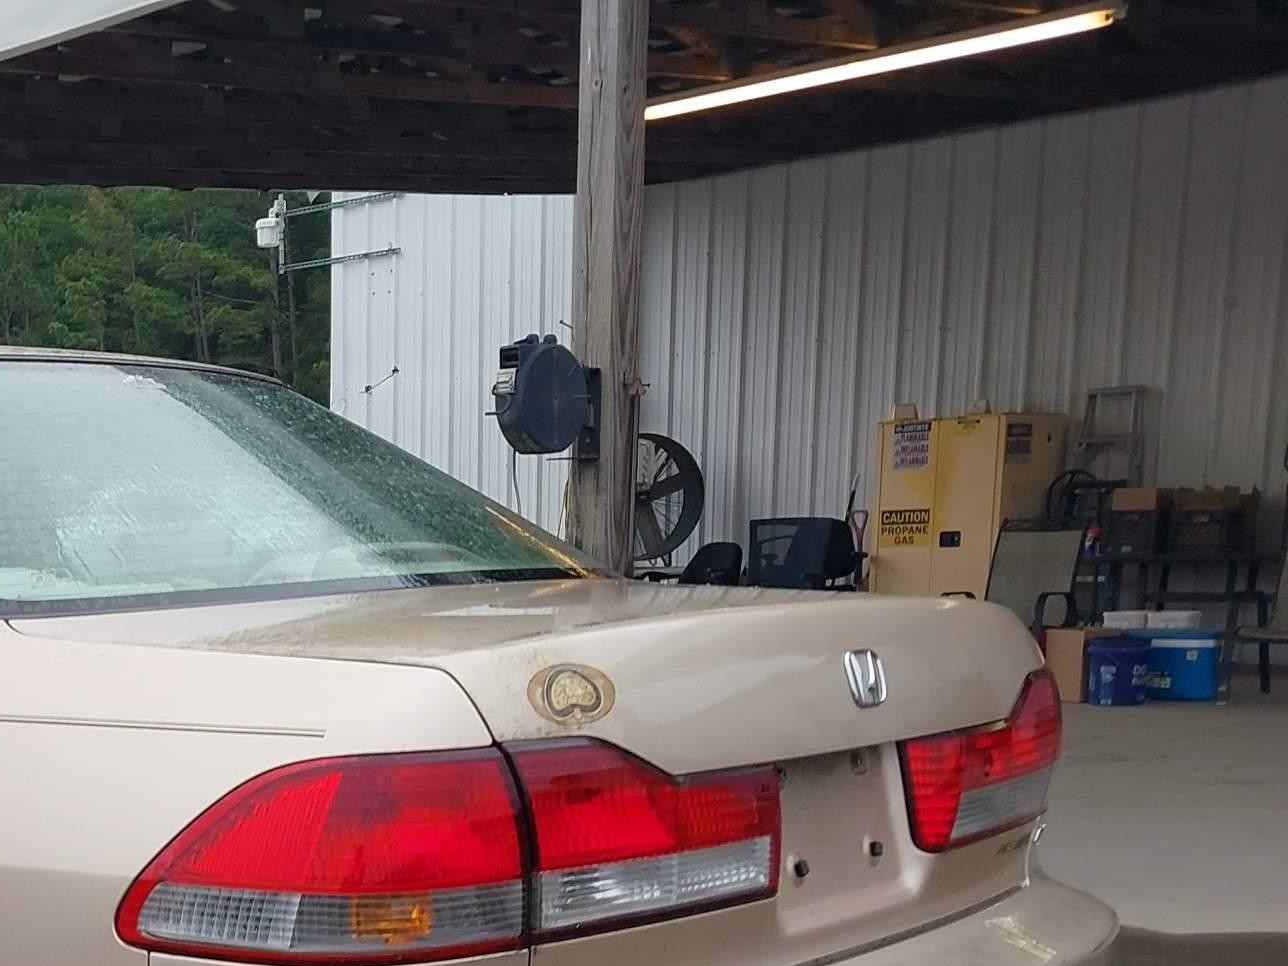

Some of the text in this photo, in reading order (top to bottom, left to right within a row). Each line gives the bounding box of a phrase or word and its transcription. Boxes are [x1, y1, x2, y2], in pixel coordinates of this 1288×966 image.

[882, 511, 929, 524] CAUTION
[881, 525, 929, 536] PROPANE
[894, 536, 915, 546] GAS
